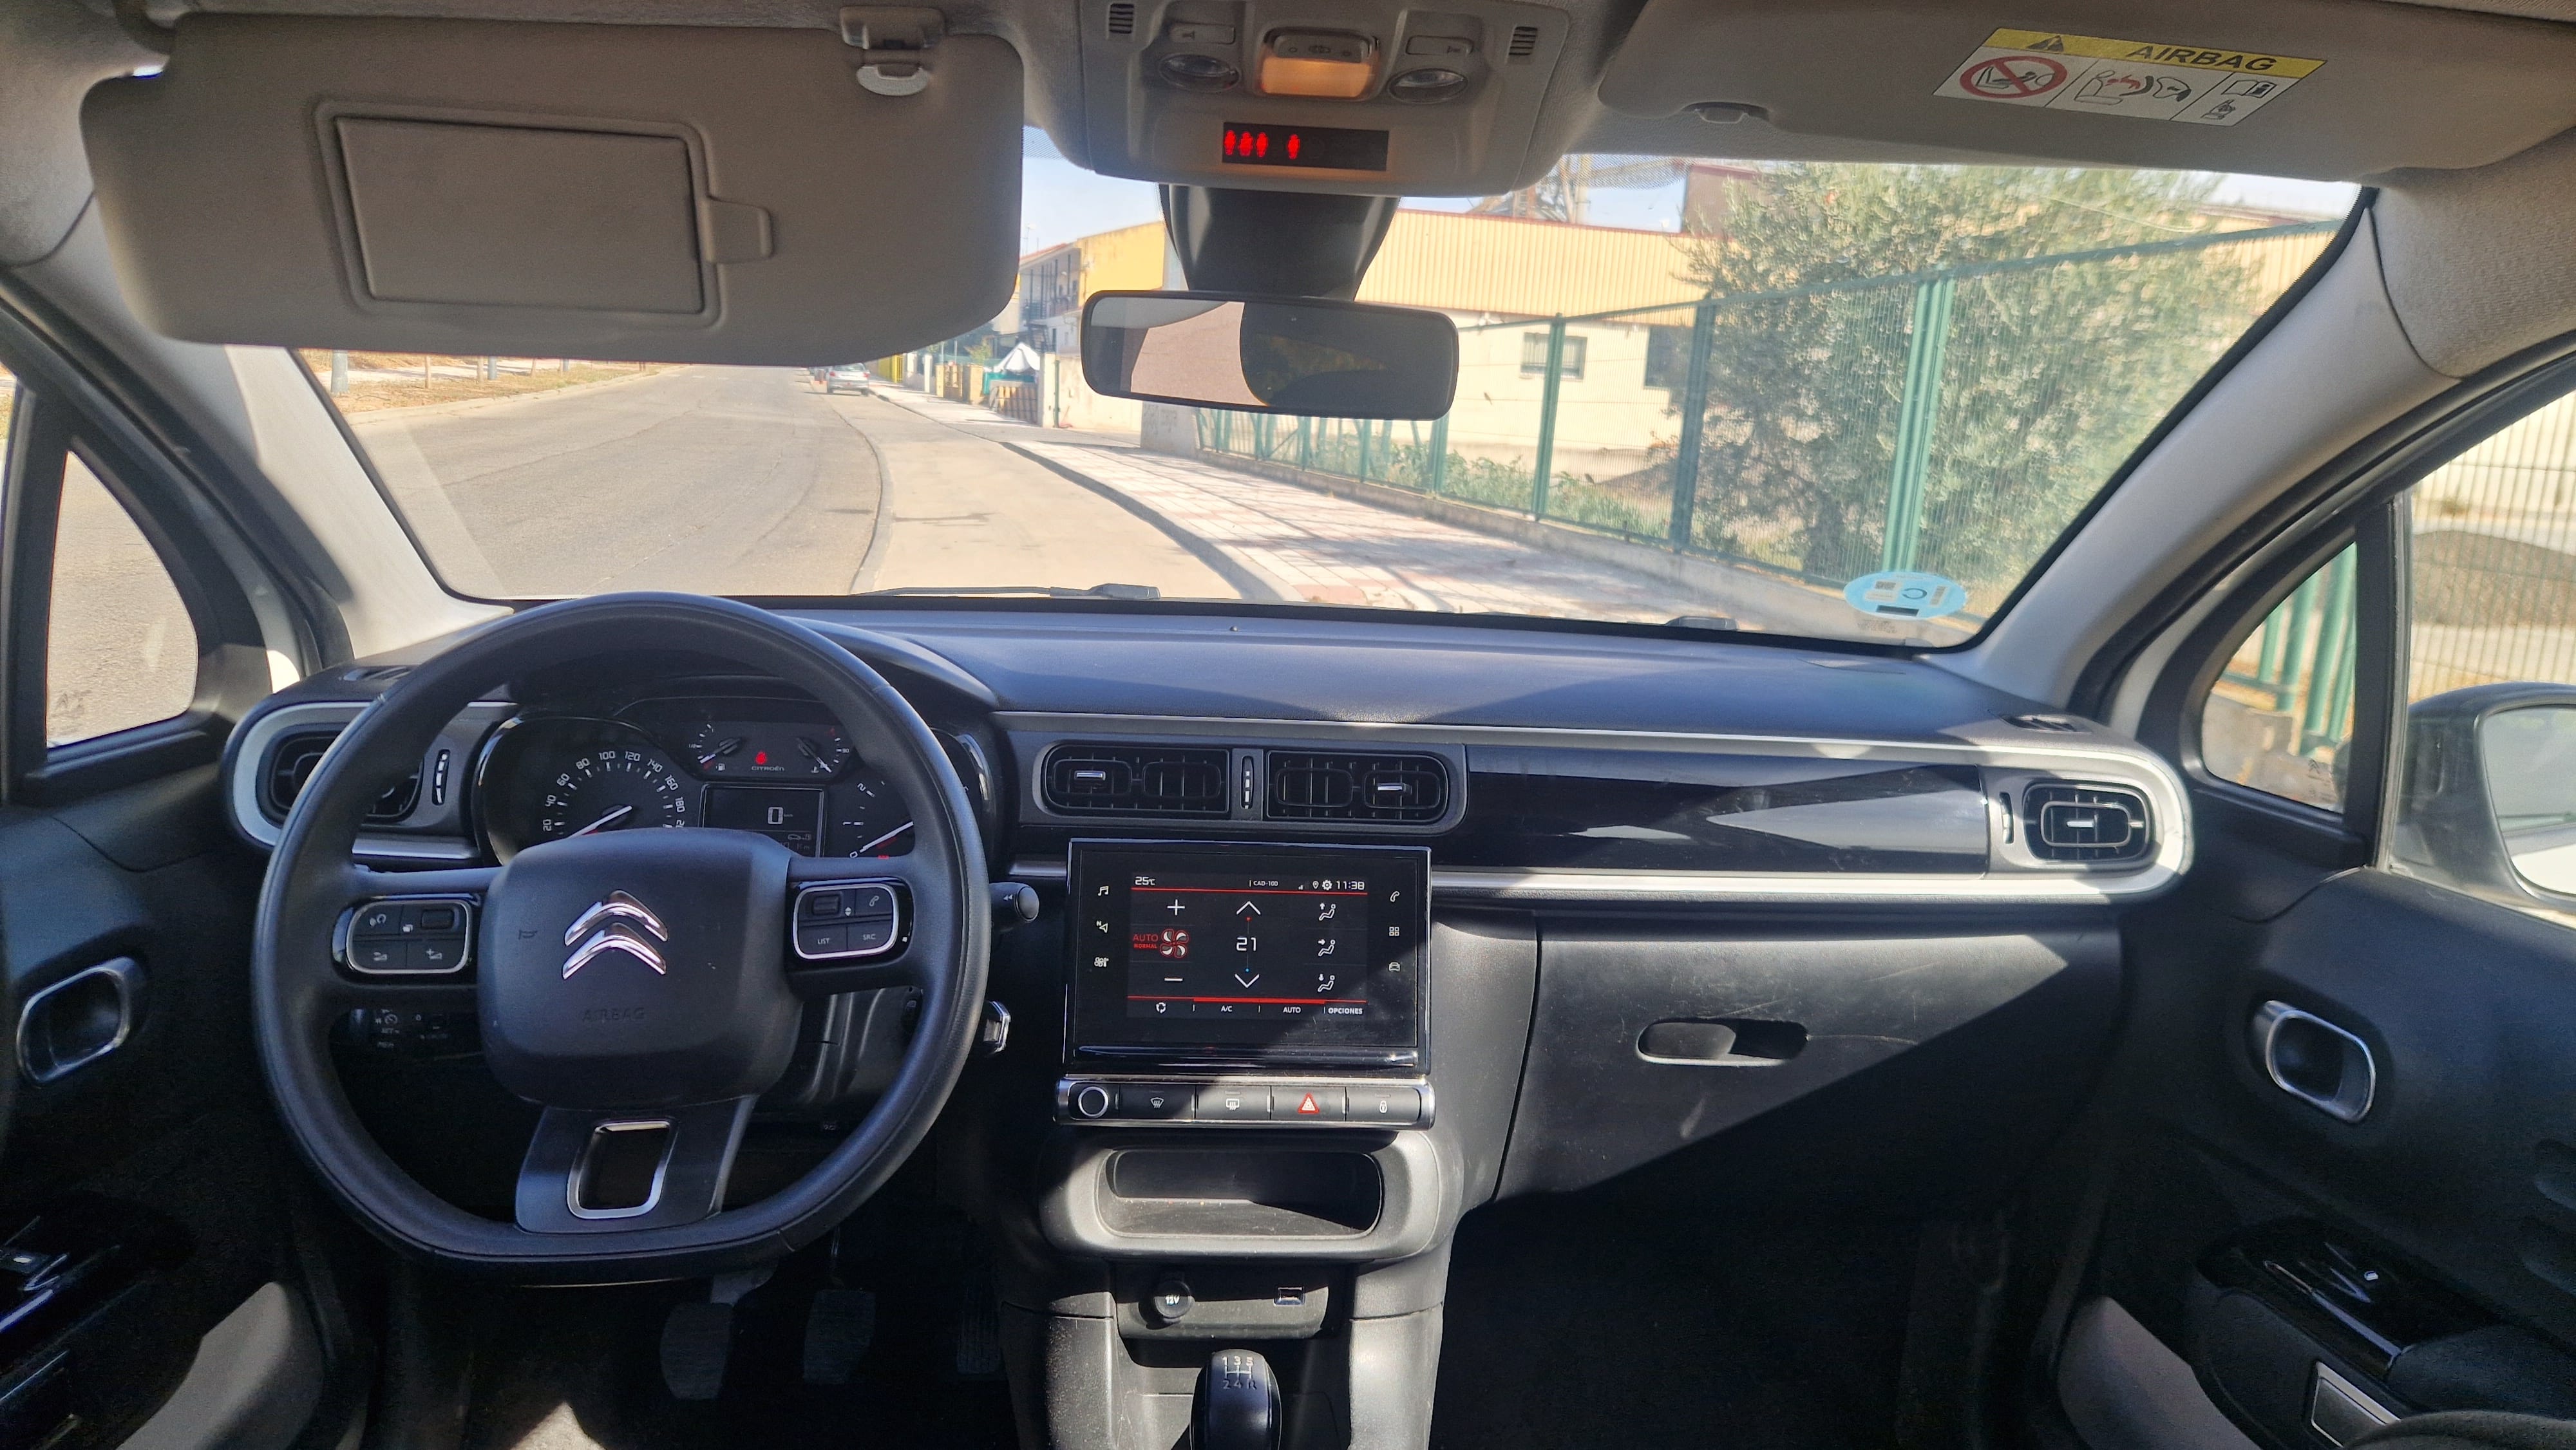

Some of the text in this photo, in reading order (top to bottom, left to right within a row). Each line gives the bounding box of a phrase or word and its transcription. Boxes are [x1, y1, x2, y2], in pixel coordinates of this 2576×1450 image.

[2125, 46, 2277, 71] AIRBAG
[598, 751, 616, 760] 100
[625, 751, 641, 762] 120
[576, 758, 591, 770] 80
[647, 758, 663, 773] 140
[556, 773, 570, 786] 60
[664, 775, 679, 791] 160
[857, 783, 866, 791] 2
[545, 795, 556, 807] 40
[675, 796, 685, 813] 180
[768, 807, 784, 824] 0
[542, 819, 552, 831] 20
[1336, 881, 1365, 890] 11:38
[1236, 937, 1256, 952] 21
[1165, 1295, 1180, 1304] 12V
[1222, 1355, 1254, 1366] 1 3 5
[1223, 1379, 1257, 1390] 2 4 R
